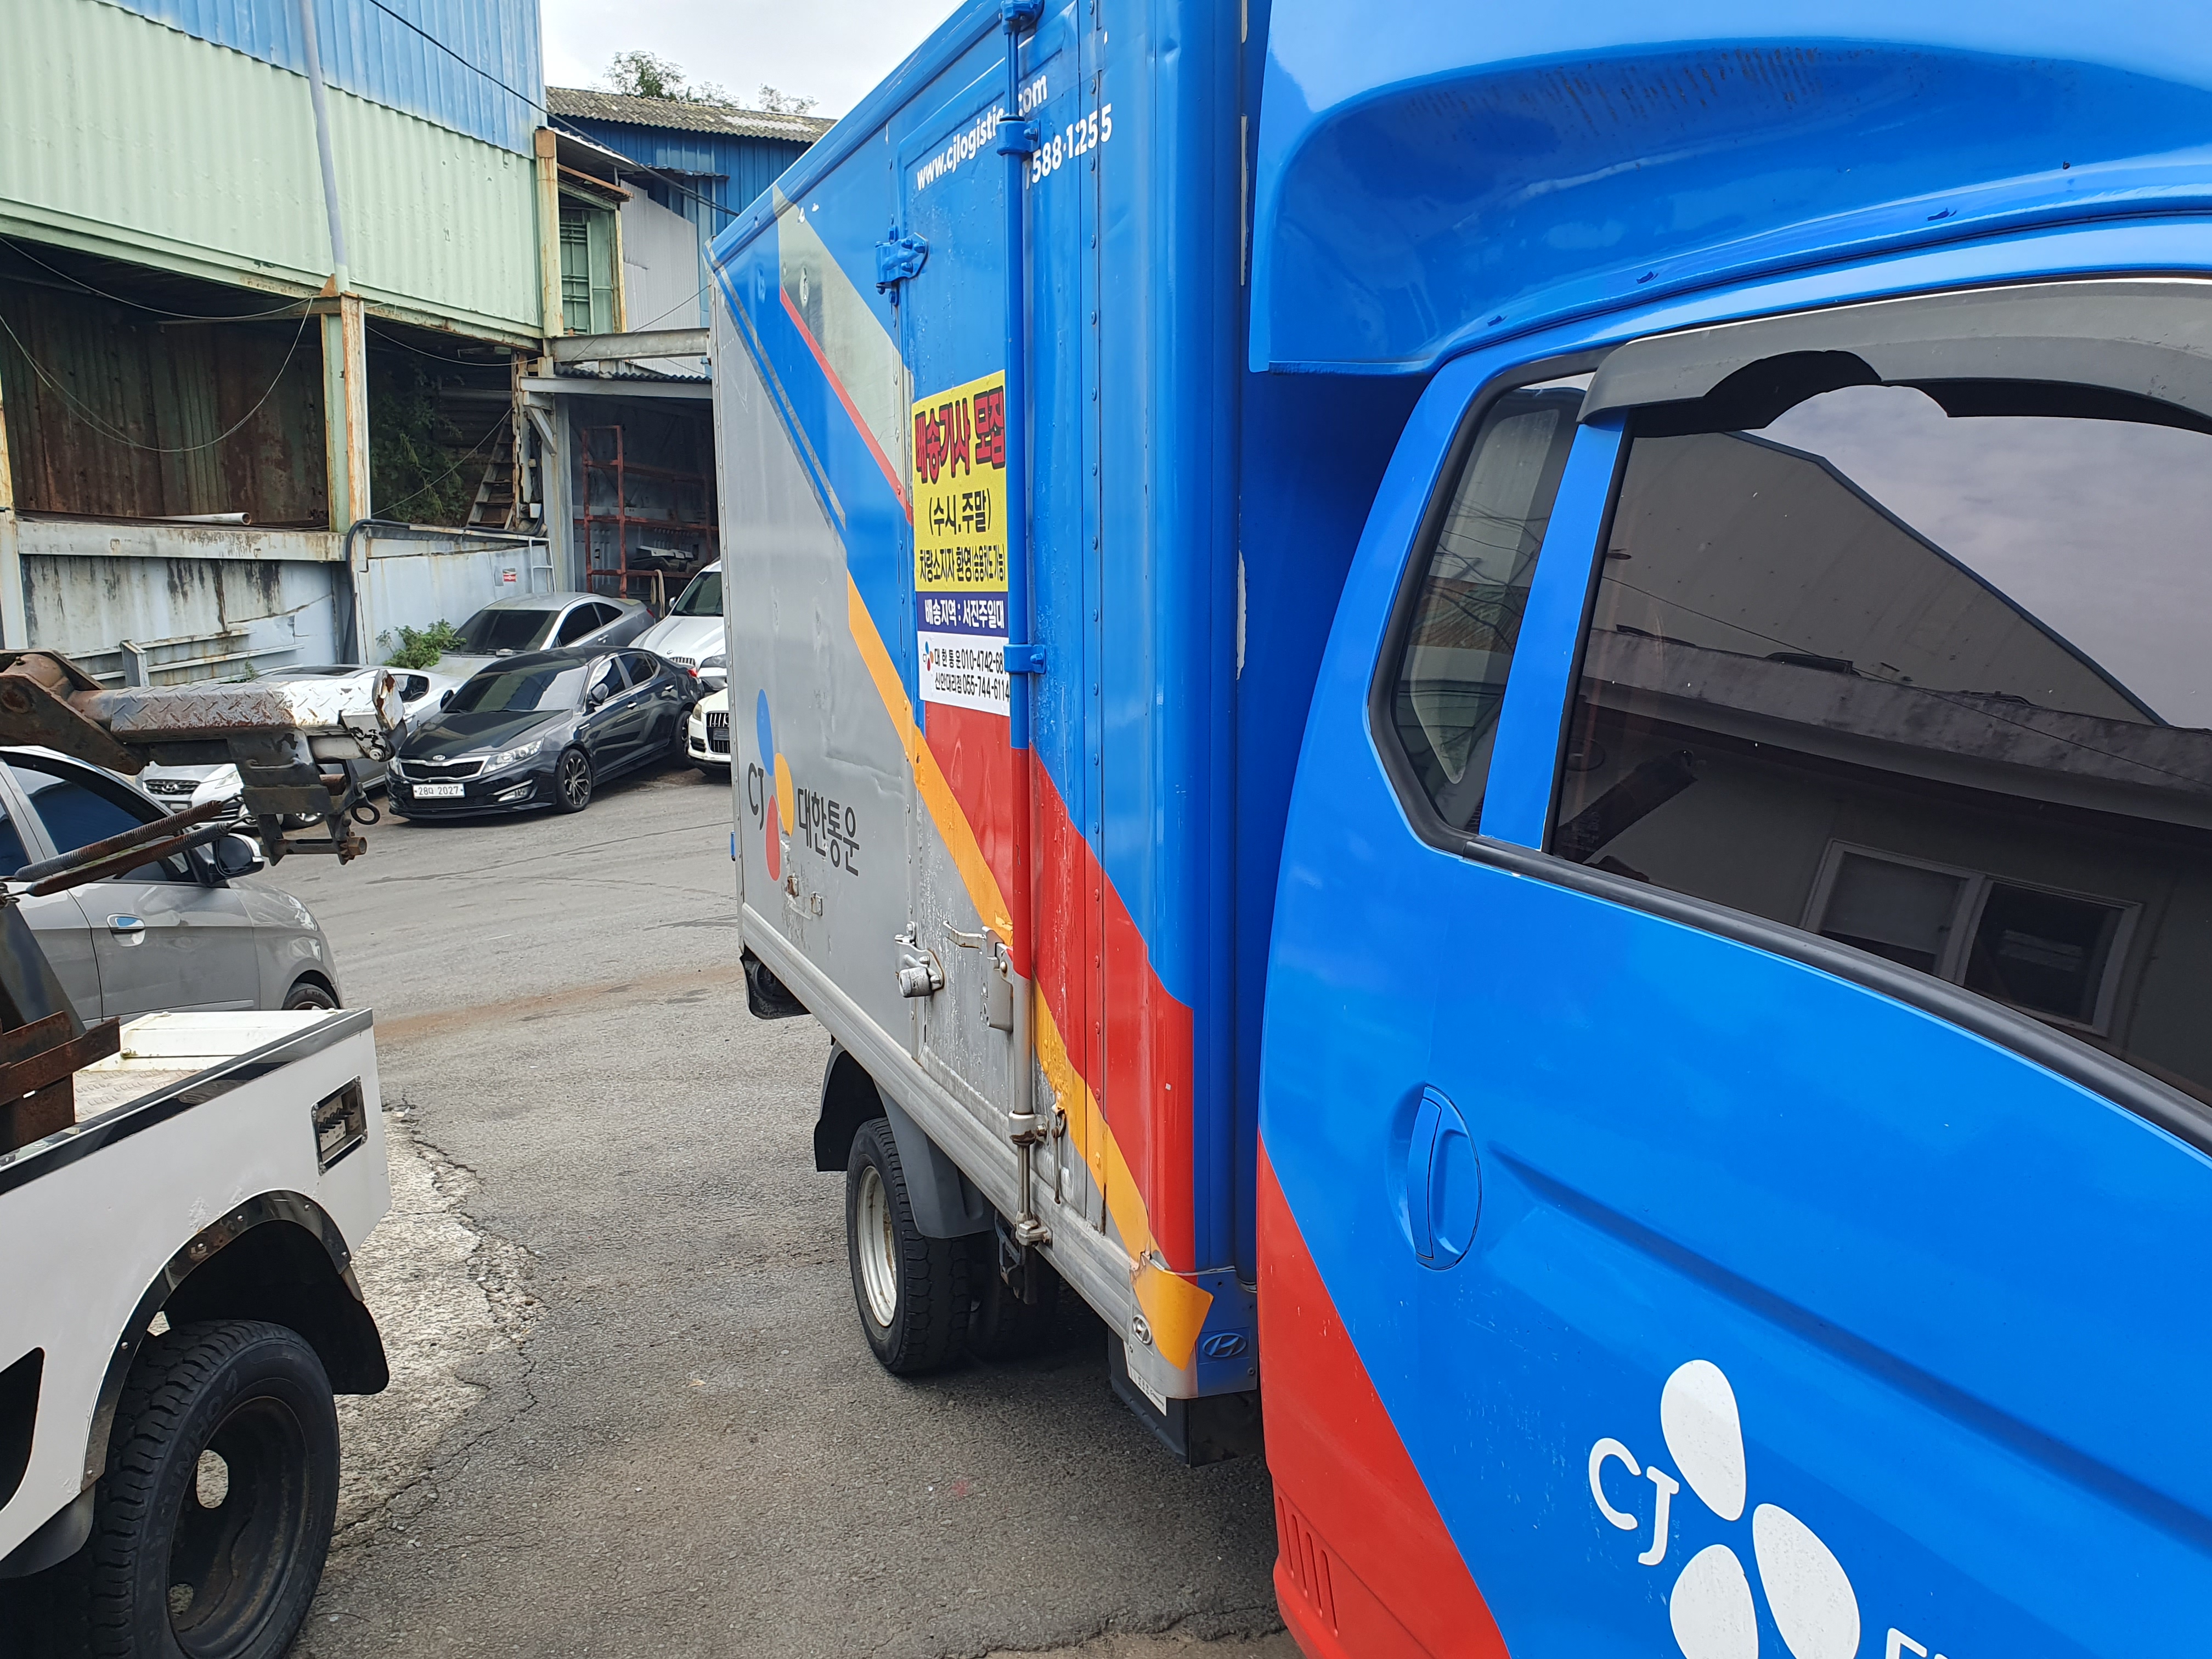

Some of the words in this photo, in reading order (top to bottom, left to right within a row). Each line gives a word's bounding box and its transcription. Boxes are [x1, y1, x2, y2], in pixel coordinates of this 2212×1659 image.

[915, 397, 970, 484] 배송기사
[974, 385, 1005, 470] 모집
[919, 548, 955, 582] 차량소지자
[963, 599, 1005, 629] 서진주일대
[961, 648, 1006, 675] 010-4742-68
[935, 672, 962, 694] 신안대리점
[962, 674, 1010, 702] 055-744-6114
[438, 786, 459, 794] 2027
[747, 762, 764, 831] CJ
[798, 787, 860, 877] 대한통운
[1588, 1437, 1679, 1566] CJ
